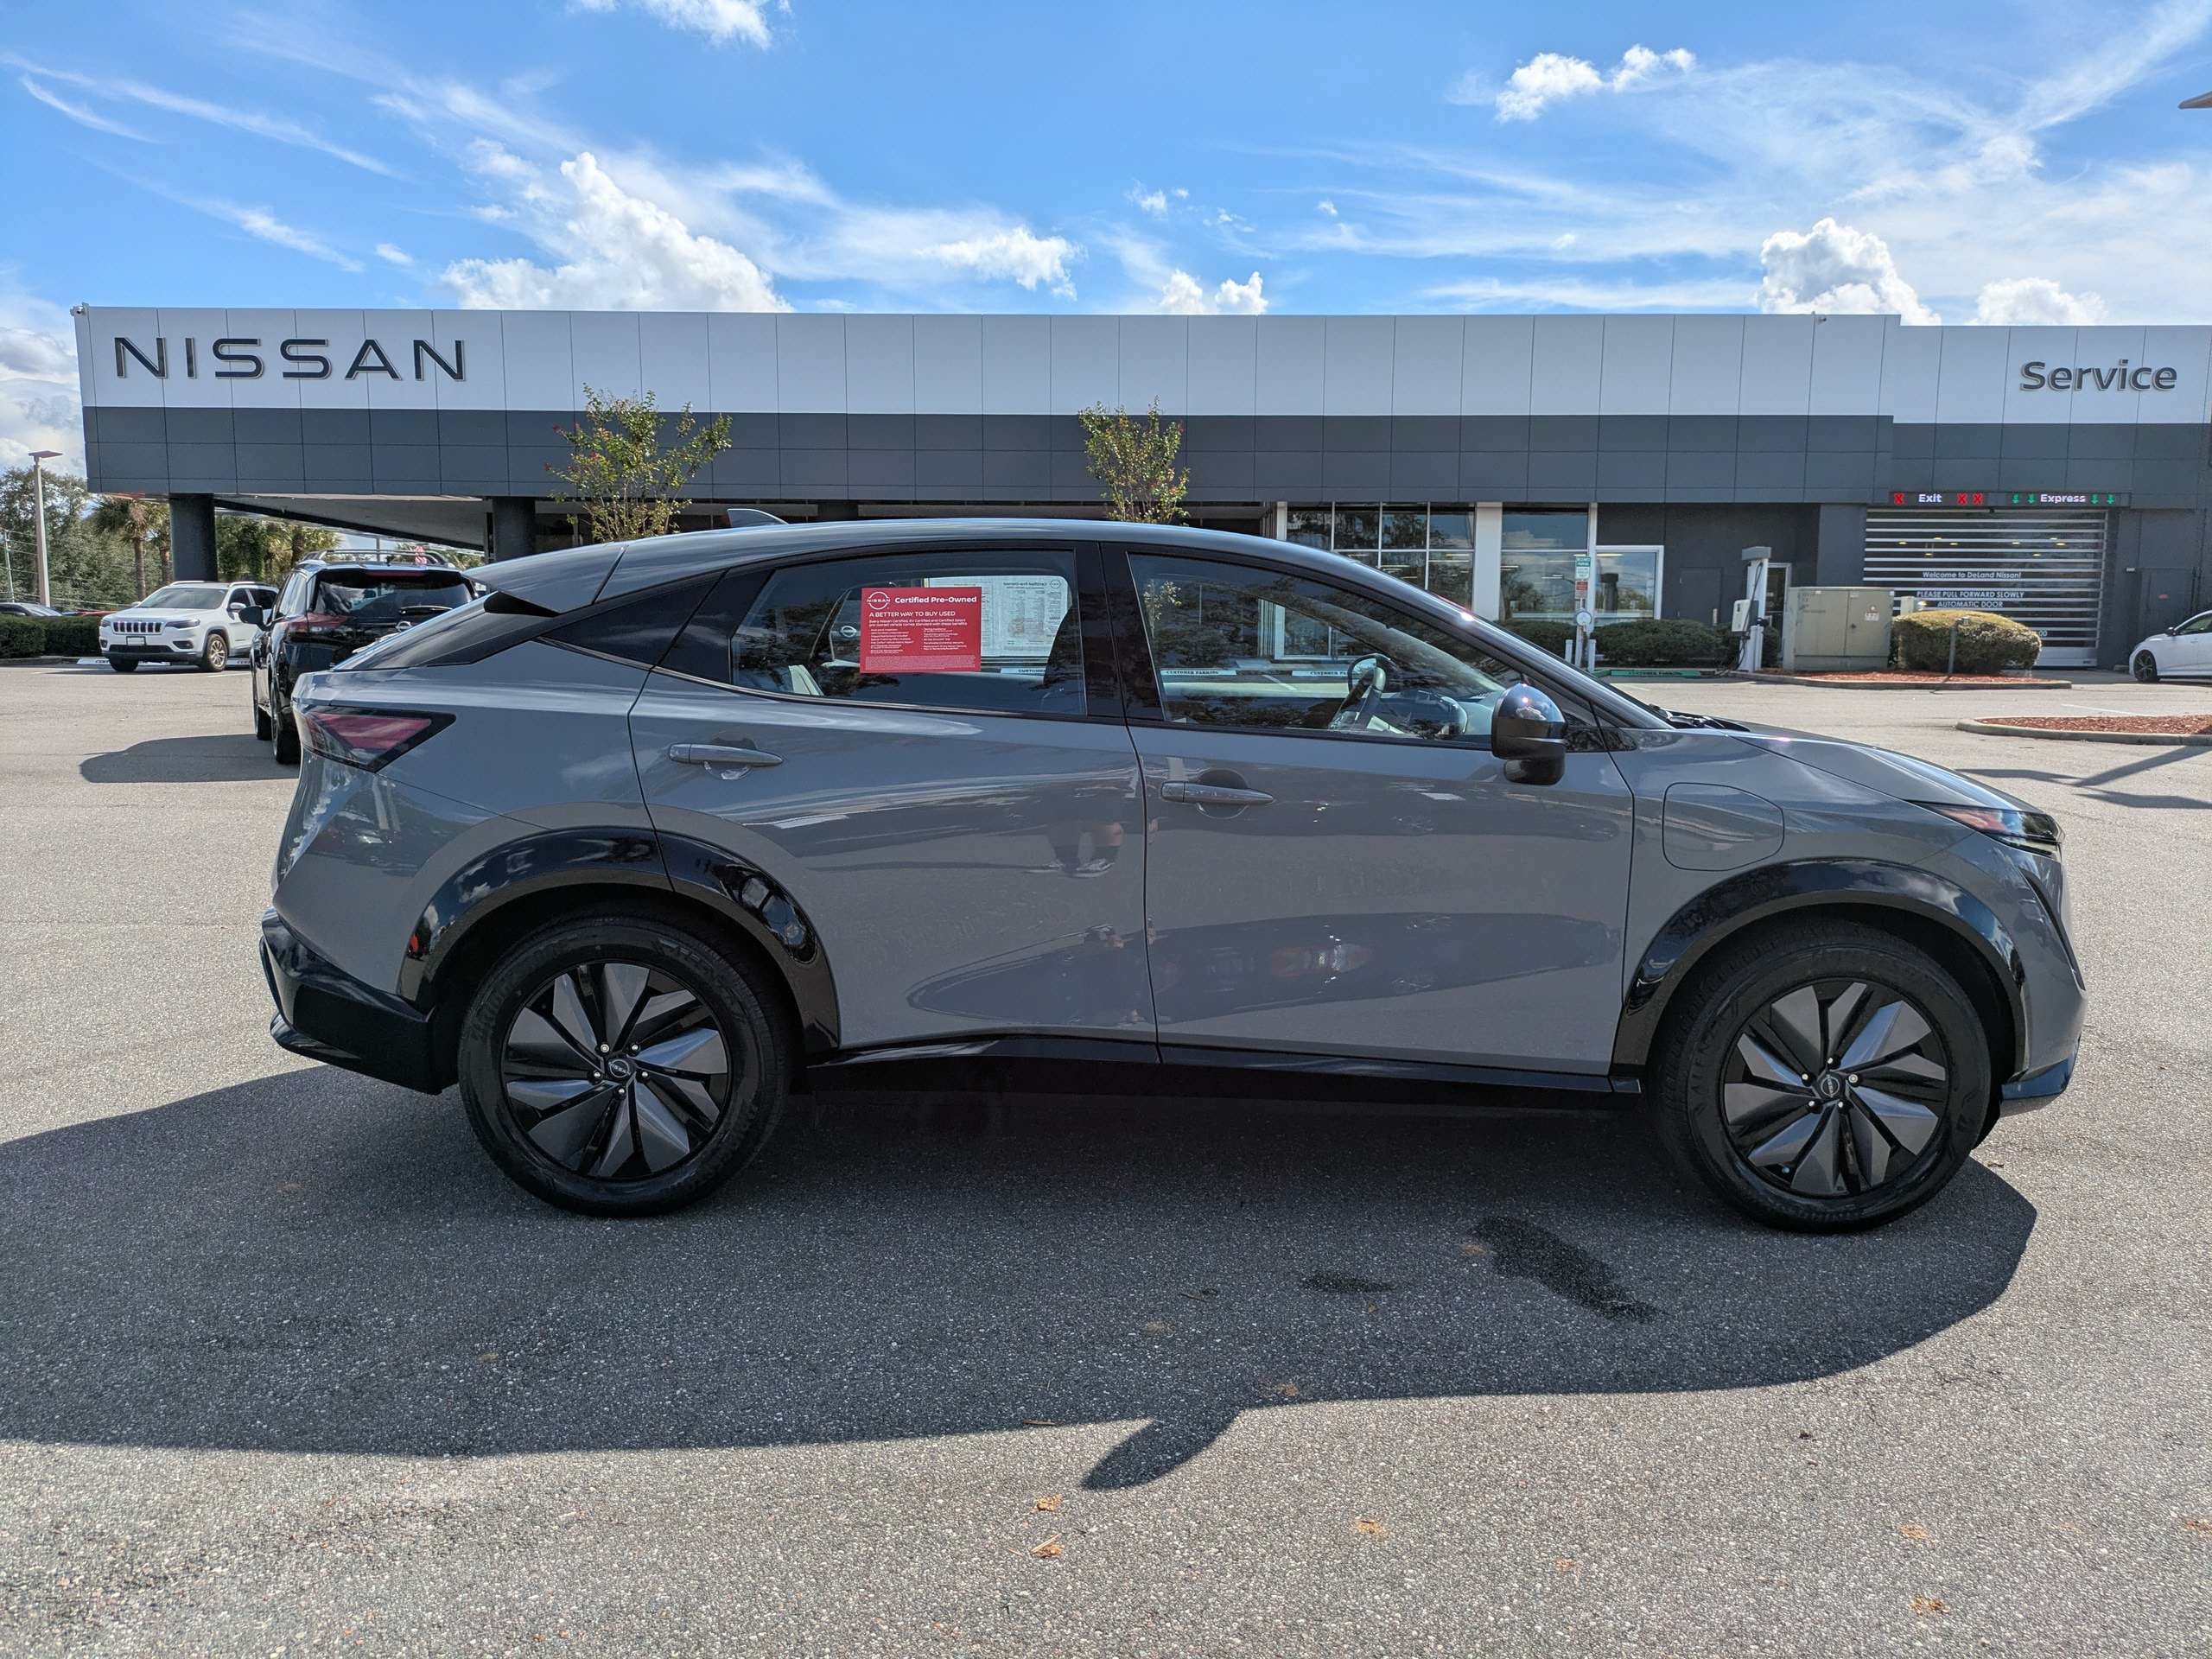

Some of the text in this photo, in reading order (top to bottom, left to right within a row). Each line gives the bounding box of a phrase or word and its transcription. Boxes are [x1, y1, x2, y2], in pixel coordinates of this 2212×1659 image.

[114, 337, 466, 381] NISSAN
[2020, 359, 2177, 391] Service
[1918, 493, 1942, 503] Exit
[2040, 493, 2086, 504] Express
